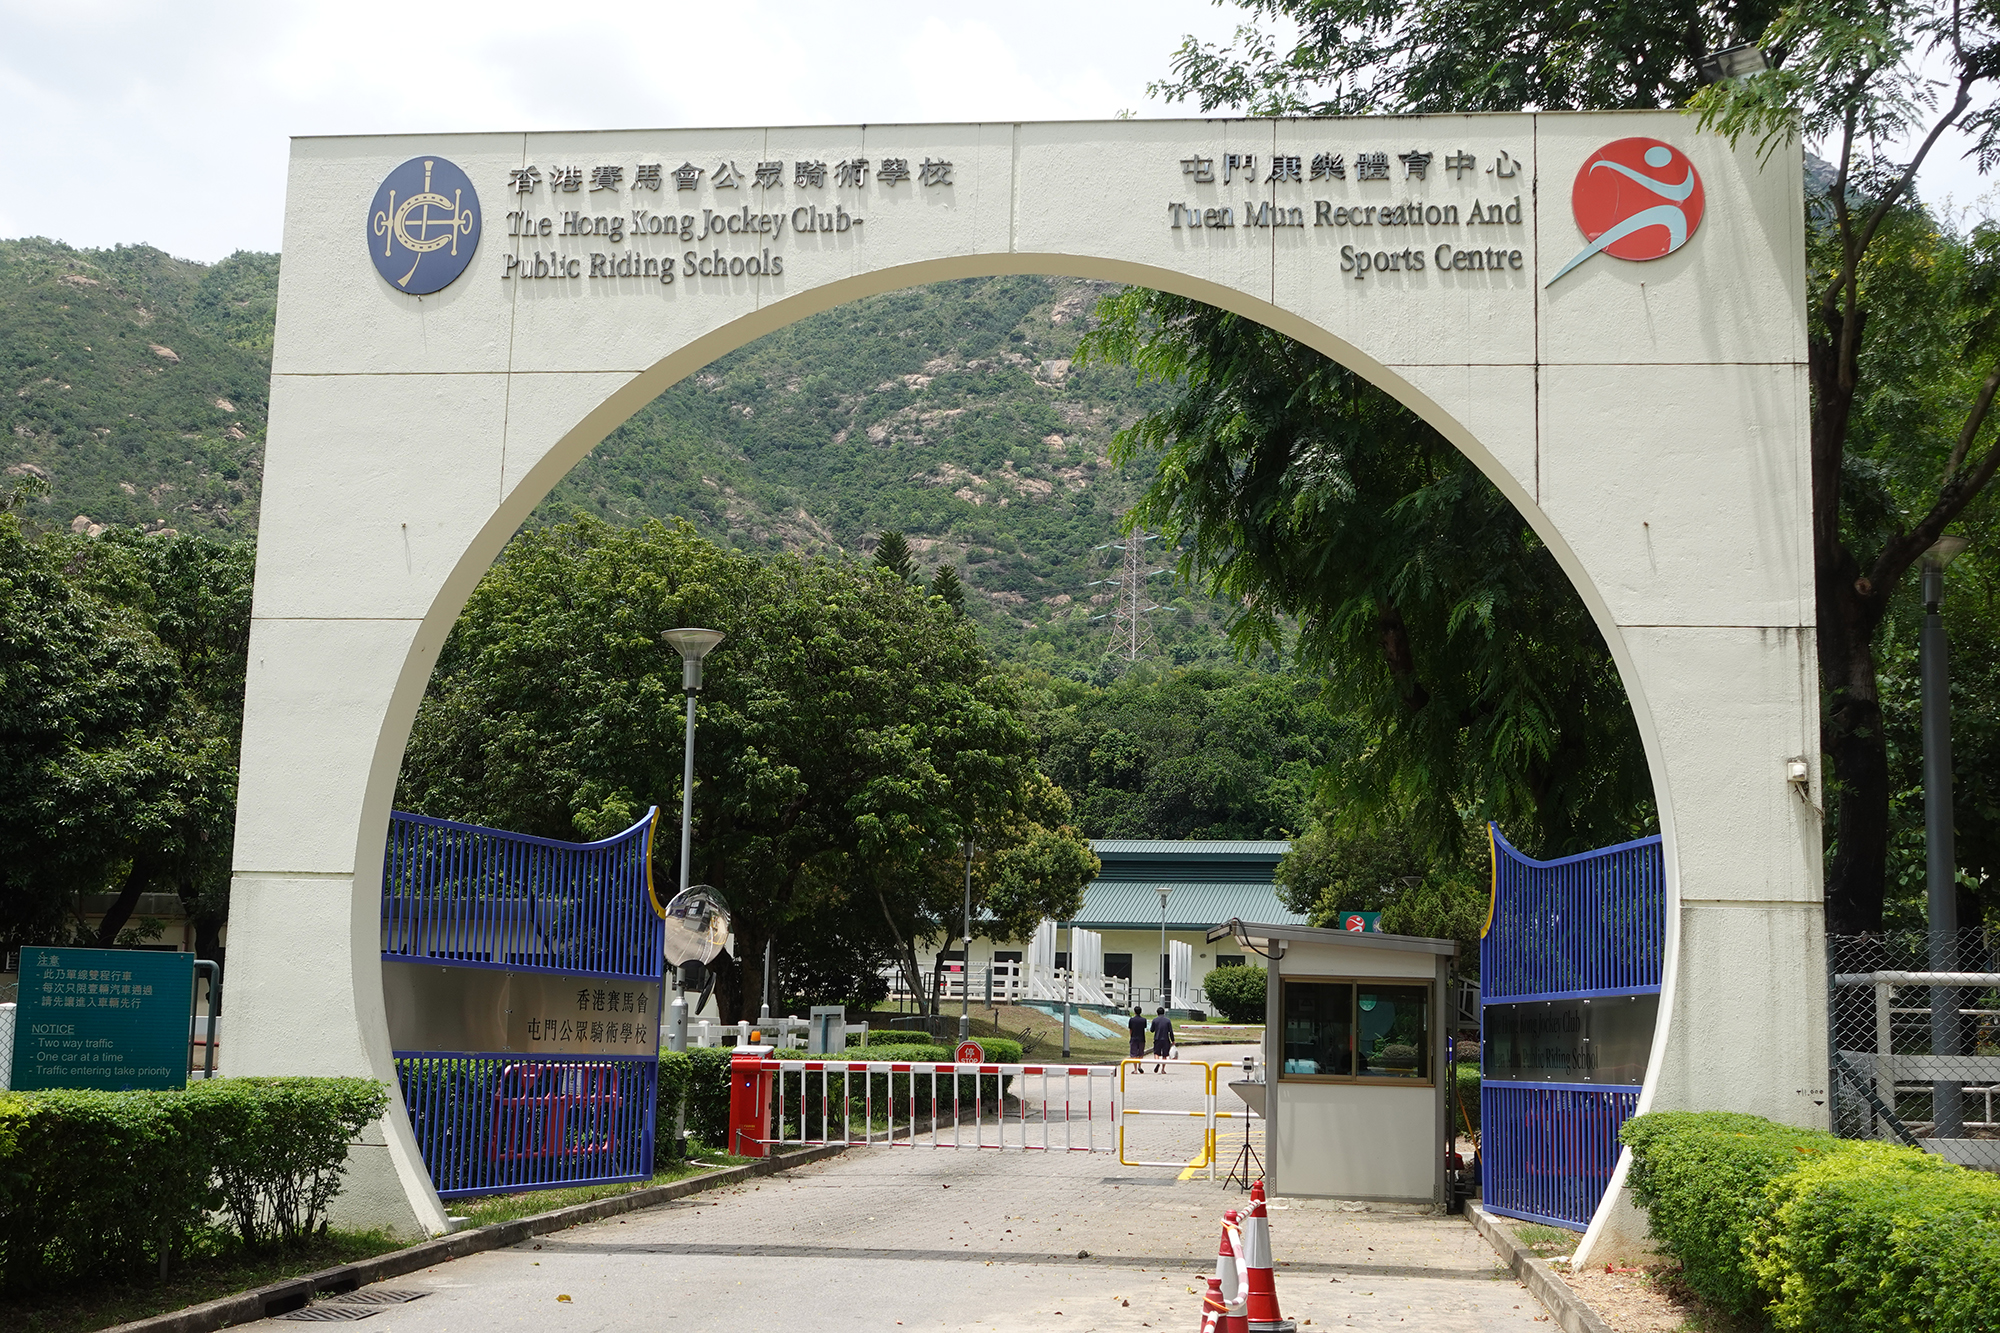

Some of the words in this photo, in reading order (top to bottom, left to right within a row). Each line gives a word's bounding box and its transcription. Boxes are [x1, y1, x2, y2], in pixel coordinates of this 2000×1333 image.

[508, 157, 953, 194] 香港賽馬會公眾騎術學校
[1180, 149, 1522, 184] 屯門康樂體育中心
[505, 210, 551, 236] The
[558, 210, 625, 242] Hong
[629, 209, 695, 242] Kong
[697, 205, 786, 241] Jockey
[1168, 201, 1234, 229] Tuen
[1243, 201, 1304, 228] Mun
[1313, 200, 1461, 227] Recreation
[1467, 197, 1522, 225] And
[501, 251, 581, 279] Public
[588, 250, 675, 284] Riding
[683, 248, 783, 277] Schools
[1340, 245, 1425, 280] Sports
[1434, 244, 1523, 271] Centre
[37, 954, 60, 967] 注意
[576, 988, 648, 1014] 香港賽馬會
[31, 1024, 75, 1034] NOTICE
[527, 1017, 648, 1045] 屯門公眾騎術學校
[1520, 1013, 1537, 1039] Kong
[1538, 1010, 1561, 1039] Jockey
[1563, 1010, 1580, 1033] Club
[36, 1052, 58, 1062] One
[61, 1054, 78, 1062] car
[80, 1053, 91, 1062] at
[102, 1052, 124, 1062] time
[38, 1038, 60, 1048] Two
[62, 1040, 83, 1051] way
[85, 1038, 114, 1049] traffic
[36, 1065, 69, 1075] Traffic
[71, 1066, 112, 1077] entering
[114, 1066, 136, 1076] take
[138, 1065, 172, 1077] priority
[1522, 1046, 1544, 1069] Public
[1546, 1046, 1571, 1076] Riding
[1572, 1045, 1599, 1070] School
